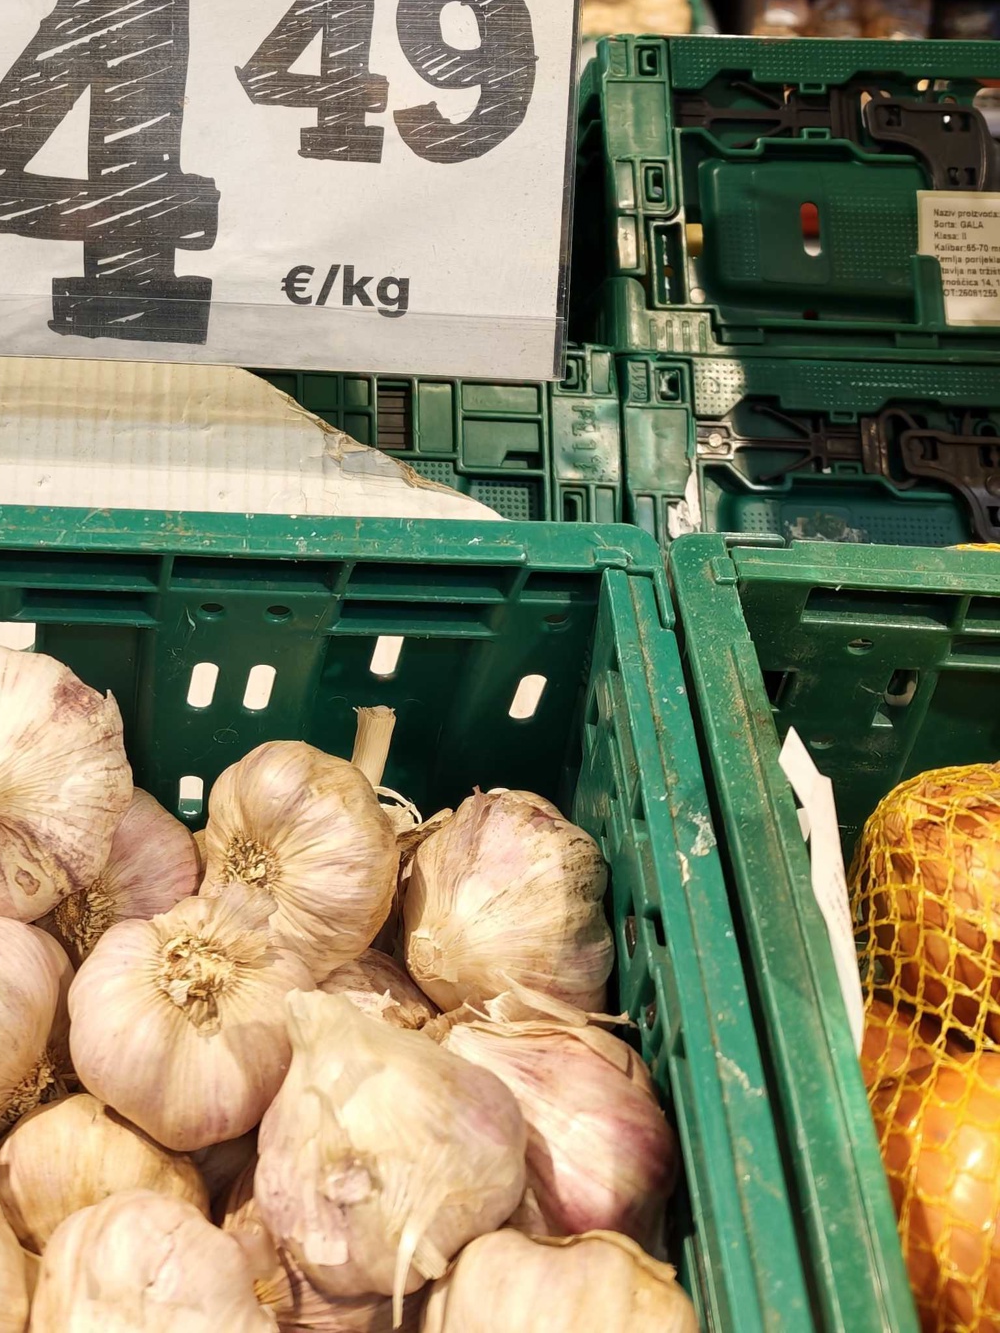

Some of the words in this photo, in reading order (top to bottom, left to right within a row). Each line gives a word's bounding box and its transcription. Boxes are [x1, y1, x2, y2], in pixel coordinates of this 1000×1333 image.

[960, 221, 984, 229] GALA
[941, 266, 964, 276] tavlja
[942, 278, 978, 286] rnoščica
[281, 264, 410, 318] €/kg
